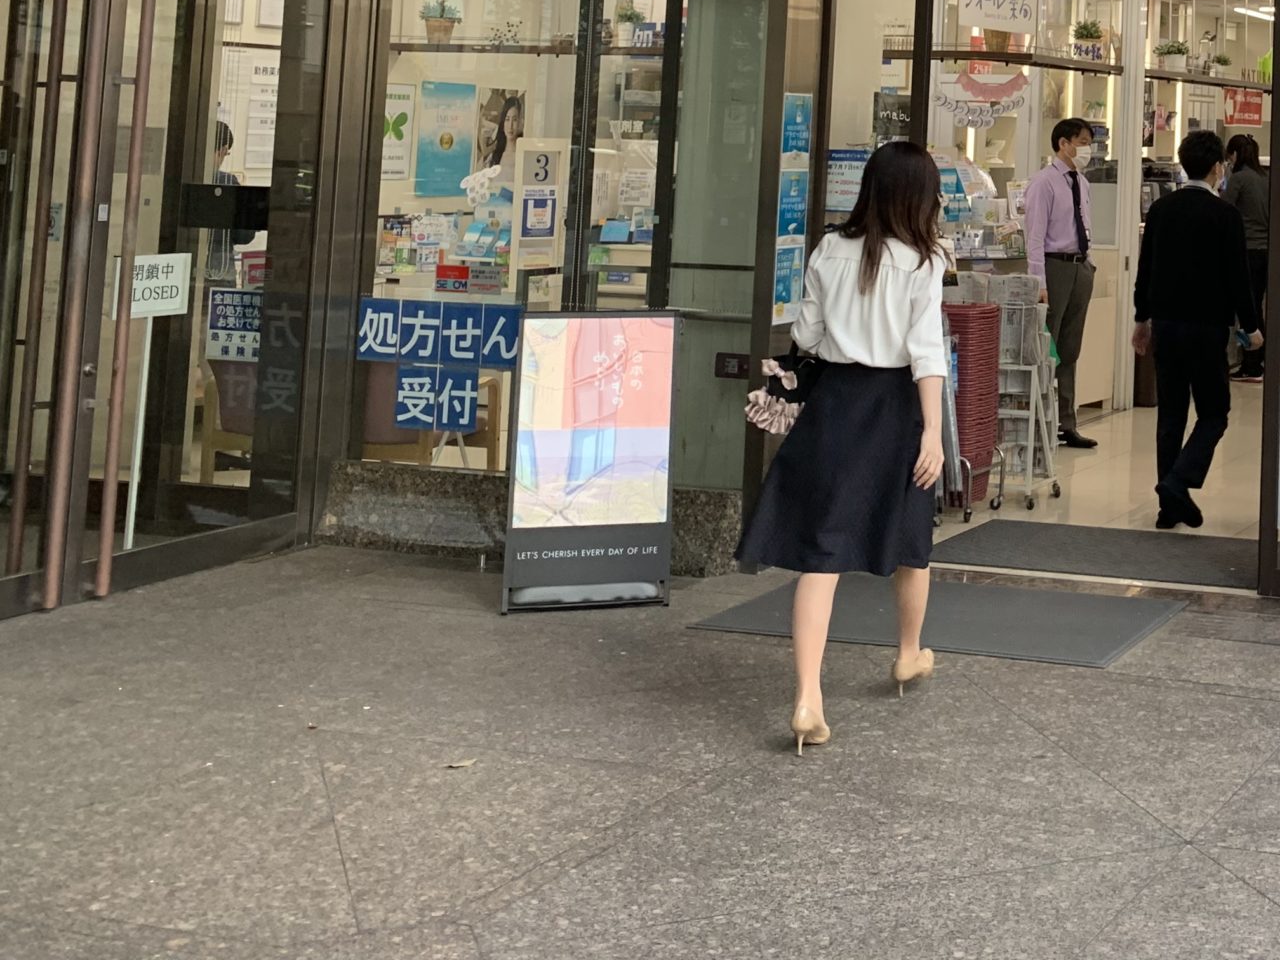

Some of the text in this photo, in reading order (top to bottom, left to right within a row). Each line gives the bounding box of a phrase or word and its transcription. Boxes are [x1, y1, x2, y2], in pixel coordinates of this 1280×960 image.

[534, 153, 549, 182] 3
[132, 285, 179, 302] LOSED
[213, 293, 264, 306] 全国医療機
[358, 307, 519, 360] 処方せん
[396, 376, 478, 425] 受付
[516, 546, 659, 560] LET'S CHERISH EVERY DAY OF LIFE
